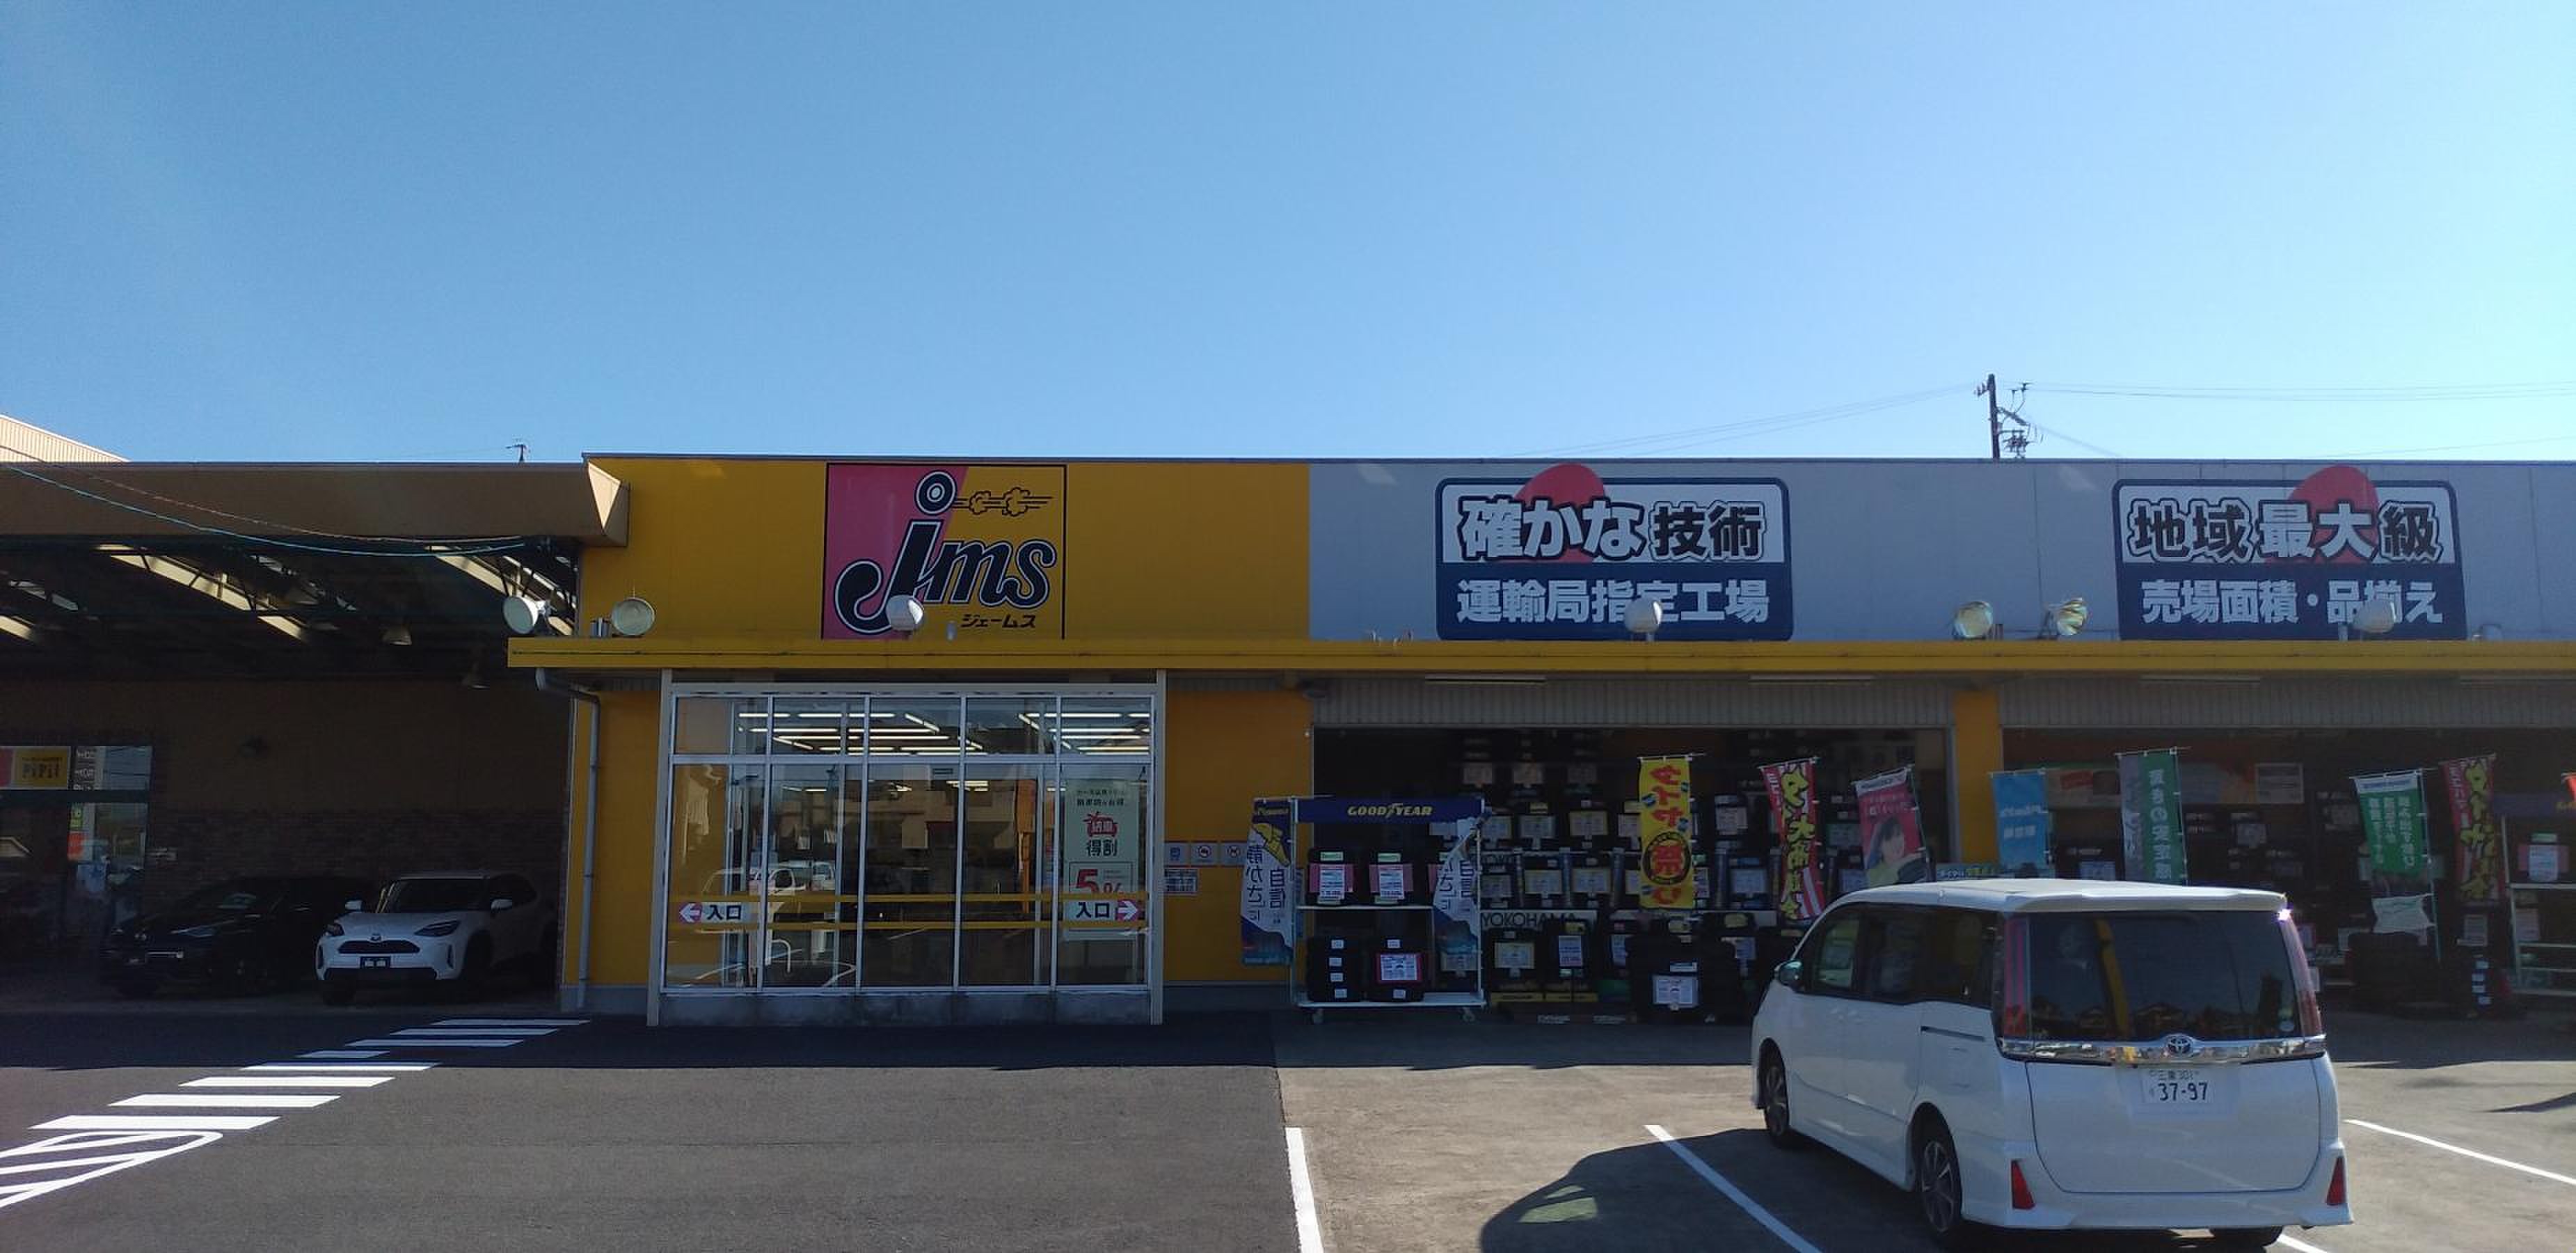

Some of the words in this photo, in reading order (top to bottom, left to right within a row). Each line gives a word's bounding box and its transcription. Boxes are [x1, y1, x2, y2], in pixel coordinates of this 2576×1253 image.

[1458, 495, 1766, 561] 確かな技術
[2127, 498, 2441, 562] 地域最大級
[1456, 578, 1770, 624] 運輸局指定工場
[961, 614, 1036, 629] ジェームス
[1347, 803, 1433, 818] GOODYEAR
[1086, 840, 1117, 856] 得割
[706, 904, 742, 922] 入口
[1076, 901, 1110, 920] 入口
